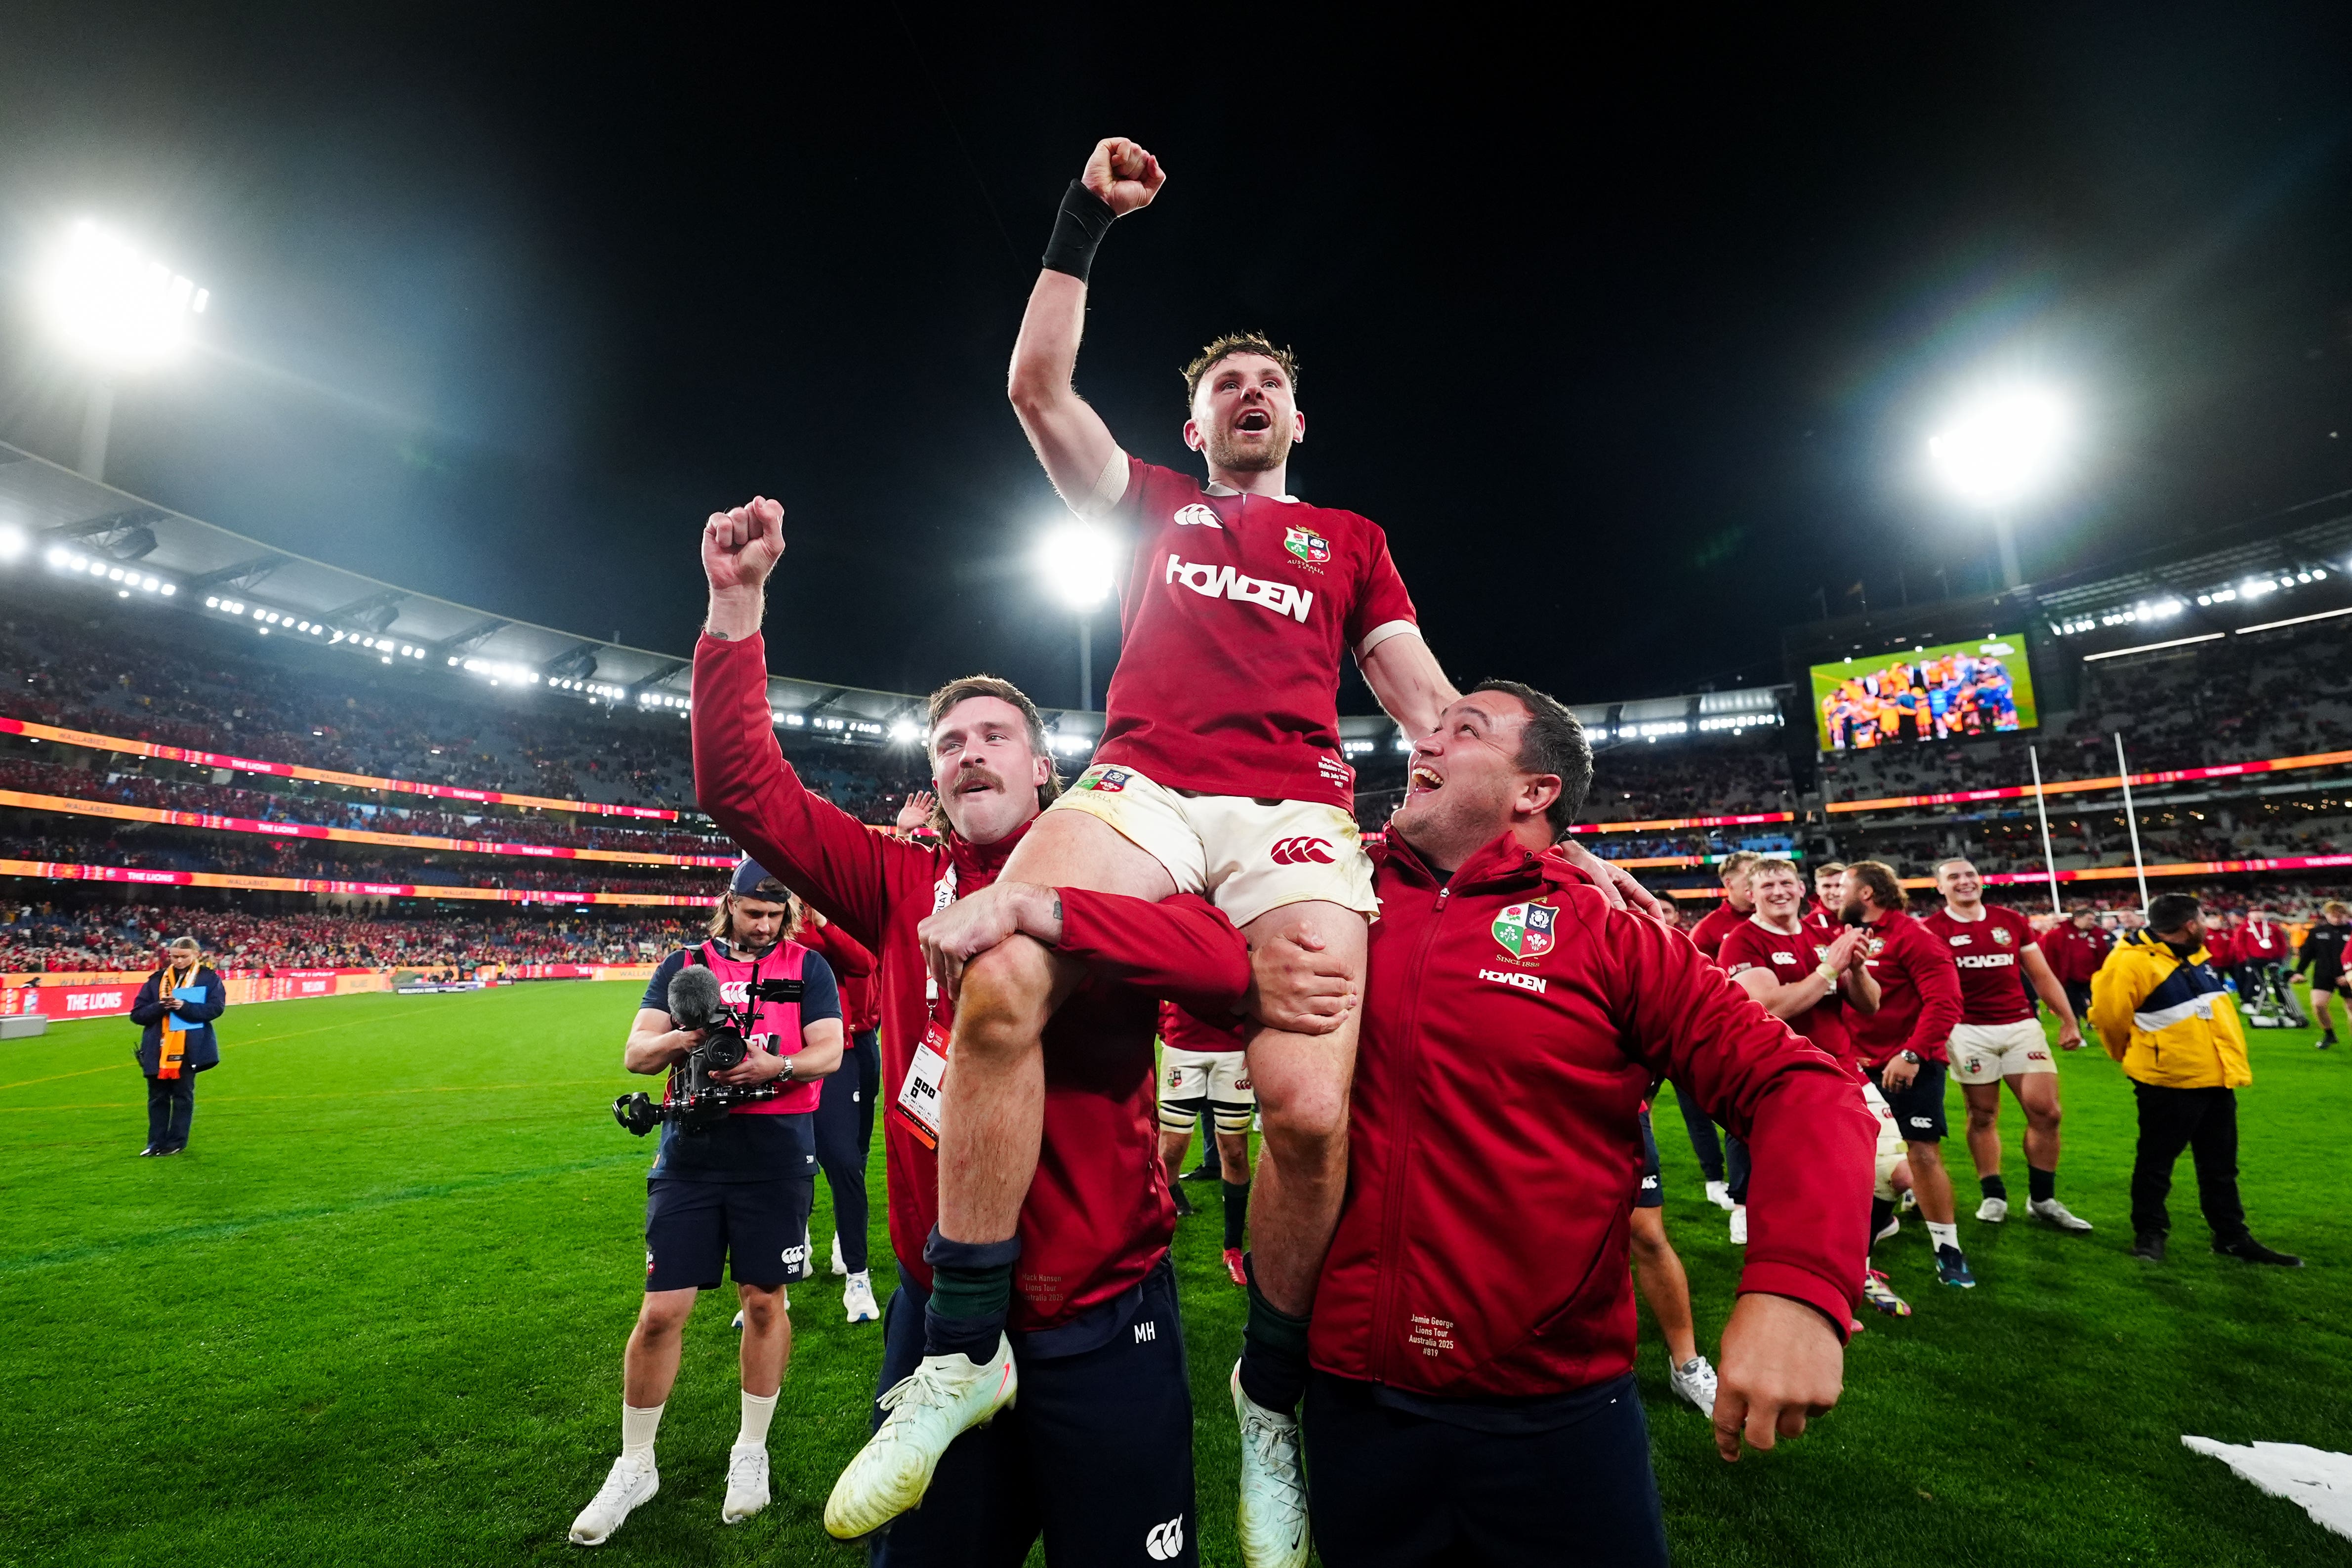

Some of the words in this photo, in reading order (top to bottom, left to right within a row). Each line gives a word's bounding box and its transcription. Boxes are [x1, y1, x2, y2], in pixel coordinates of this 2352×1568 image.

[1287, 559, 1324, 575] AUSTRALIA
[1166, 554, 1314, 623] HOWDEN
[57, 732, 107, 746] WALLABIES
[231, 760, 247, 769] THE
[247, 763, 271, 772] LIONS
[320, 773, 356, 784] WALLABIES
[64, 802, 114, 815] WALLABIES
[258, 823, 274, 832] THE
[274, 825, 298, 835] LIONS
[127, 871, 146, 881] THE
[146, 872, 174, 882] LIONS
[227, 878, 269, 887] WALLABIES
[1496, 954, 1521, 966] SINCE
[1955, 953, 2015, 968] HOWDEN
[59, 977, 120, 987] WALLABIES
[1479, 968, 1547, 994] HOWDEN
[66, 994, 89, 1011] THE
[89, 991, 123, 1010] LIONS
[1022, 1273, 1037, 1281] Mack
[1026, 1283, 1042, 1291] Lions
[1411, 1314, 1430, 1324] Jamie
[1431, 1317, 1454, 1329] George
[1134, 1321, 1156, 1344] MH
[1415, 1325, 1433, 1336] Lions
[1434, 1327, 1448, 1338] Tour
[1408, 1334, 1437, 1347] Australia
[1438, 1339, 1454, 1350] 2025
[1423, 1347, 1439, 1357] #819
